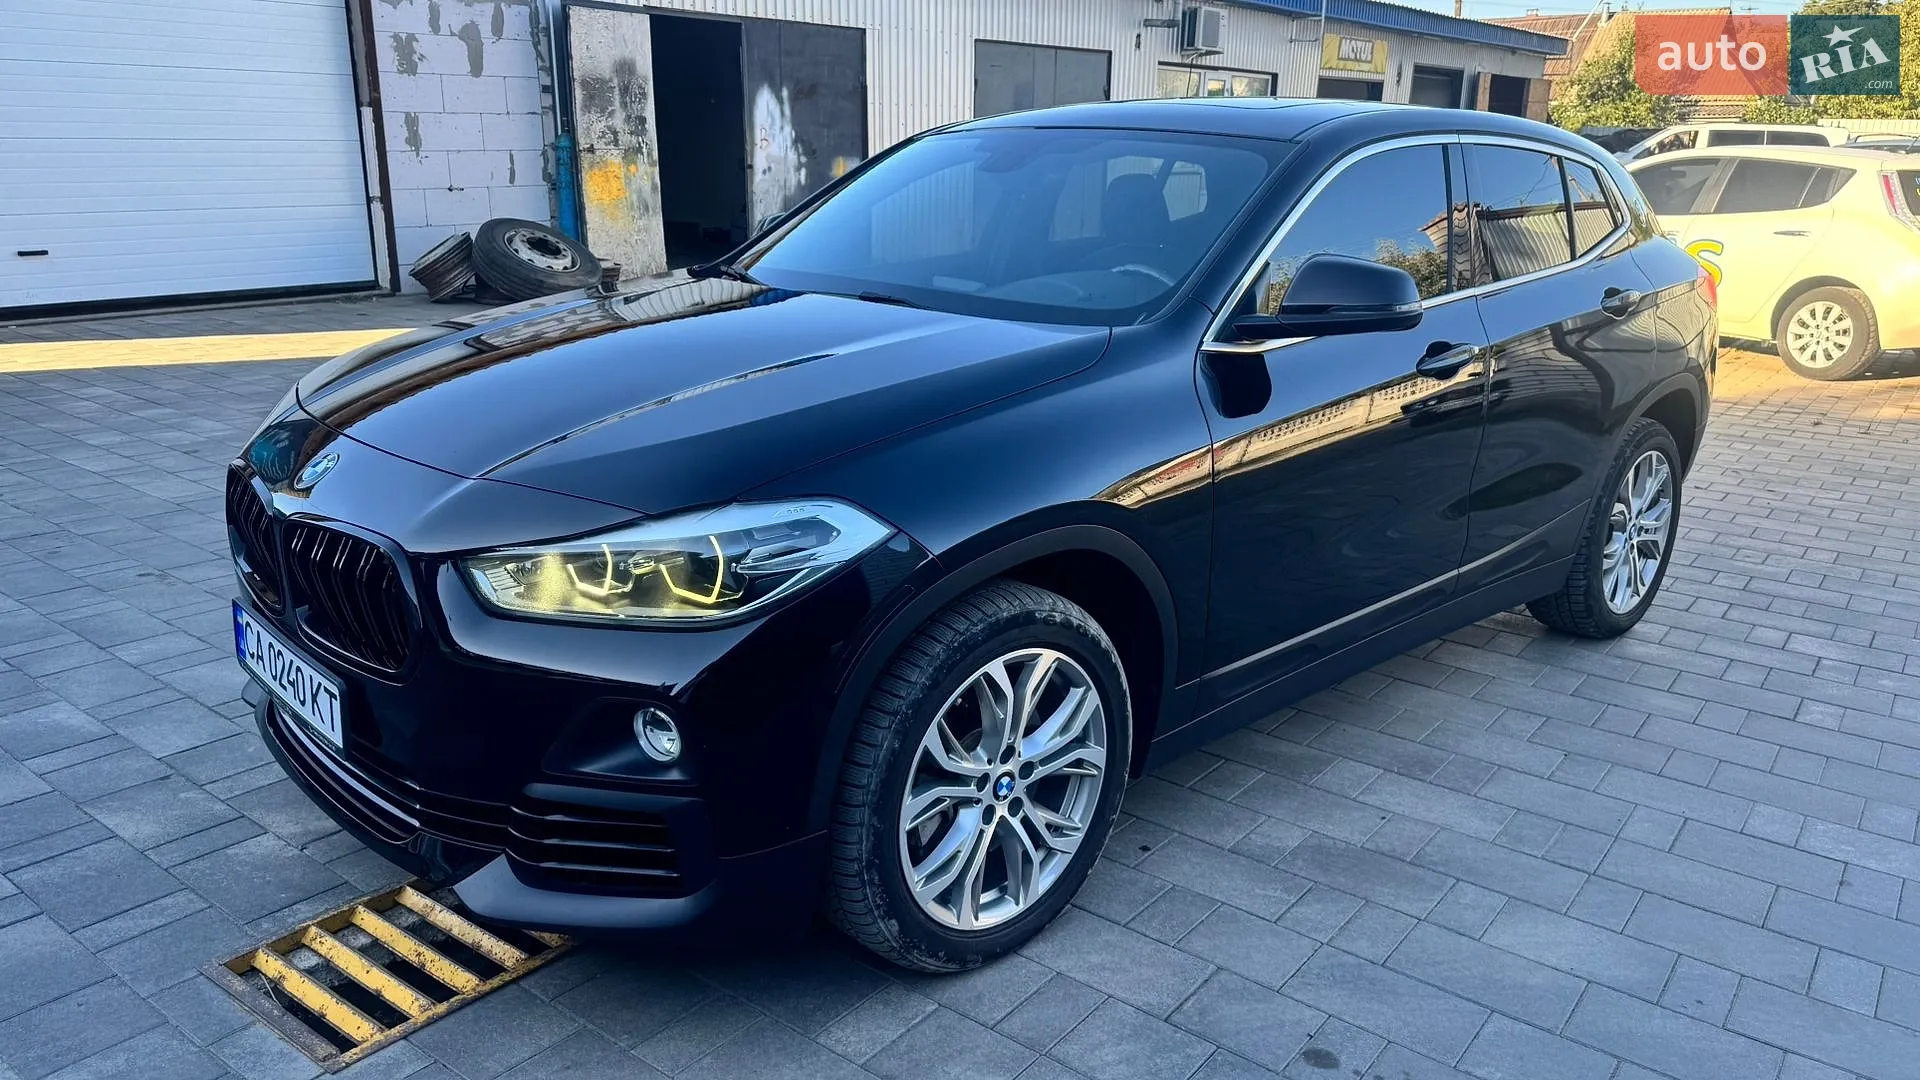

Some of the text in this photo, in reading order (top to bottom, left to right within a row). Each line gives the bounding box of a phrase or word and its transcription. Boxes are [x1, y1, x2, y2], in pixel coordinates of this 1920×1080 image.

[1339, 38, 1374, 61] MOTUL
[244, 620, 338, 732] CA 0240 KT
